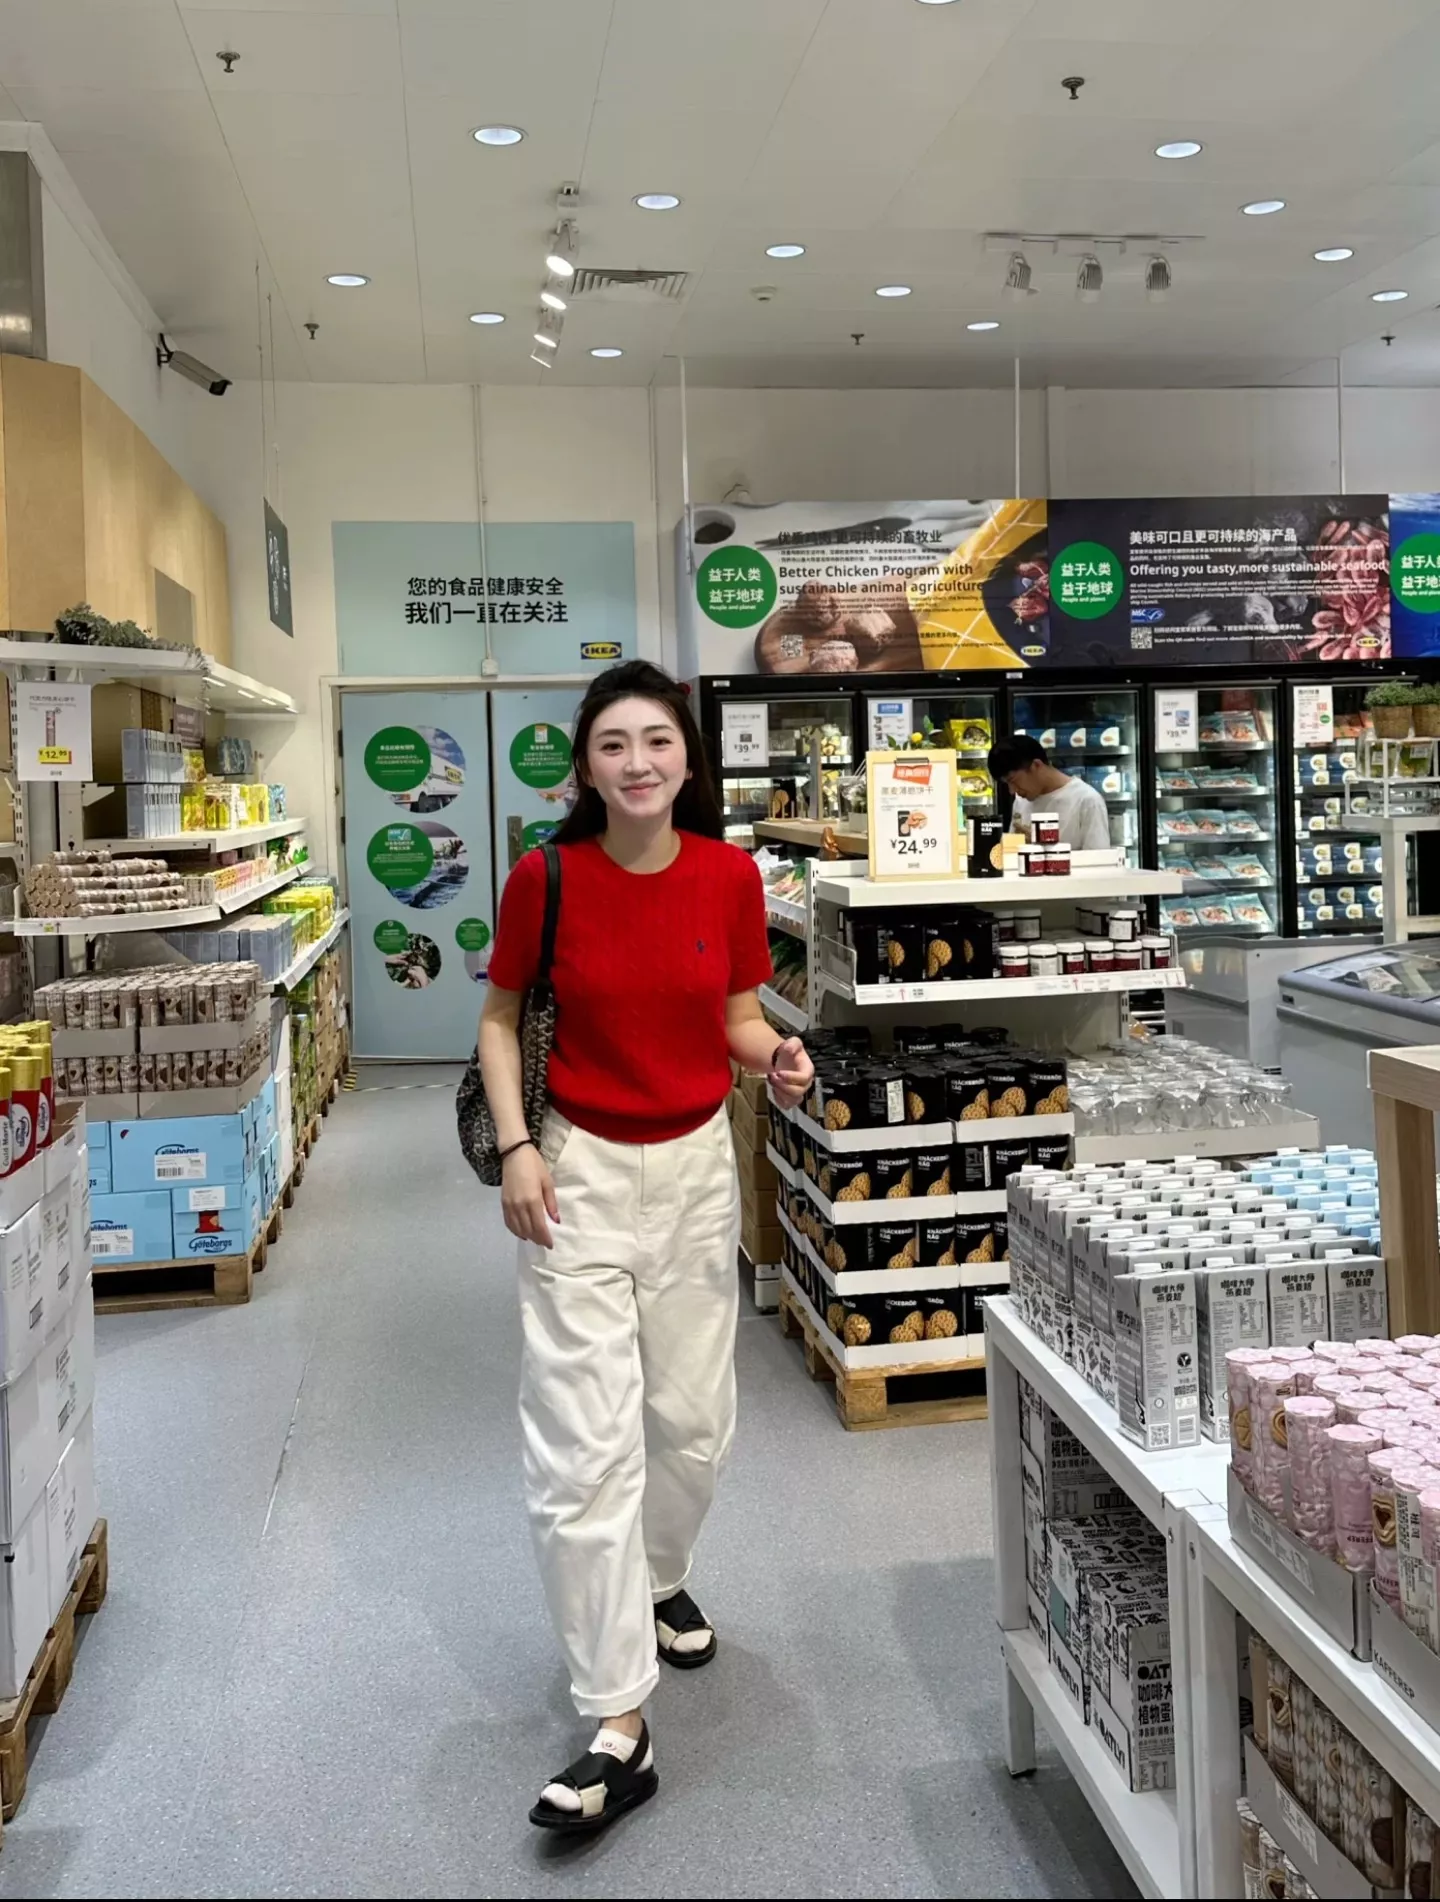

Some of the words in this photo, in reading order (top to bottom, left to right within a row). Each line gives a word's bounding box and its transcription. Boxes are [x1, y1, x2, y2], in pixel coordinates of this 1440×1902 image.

[836, 531, 943, 544] 更可持续的畜牧业
[1130, 528, 1297, 544] 美味可口且更可持续的海产品
[708, 567, 761, 582] 益于人类
[779, 567, 822, 578] Better
[825, 565, 878, 578] Chicken
[883, 565, 939, 578] Program
[943, 562, 974, 575] with
[1061, 562, 1111, 577] 益于人类
[1130, 565, 1179, 578] Offering
[1182, 566, 1204, 577] you
[1206, 564, 1270, 575] tasty,more
[1271, 562, 1338, 573] sustainable
[1340, 560, 1386, 572] seafood
[407, 576, 564, 597] 您的食品健康安全
[779, 582, 857, 595] sustainable
[861, 581, 908, 593] animal
[910, 580, 984, 595] agriculture
[1062, 581, 1114, 596] 益于地球
[1402, 575, 1440, 589] 益于地
[709, 588, 764, 603] 益于地球
[405, 601, 568, 624] 我们一直在关注
[584, 647, 619, 655] IKEA
[890, 838, 938, 855] ¥24.99
[189, 1236, 232, 1252] Göteborgs
[1374, 1648, 1416, 1700] KAFFEREP
[1137, 1681, 1172, 1703] 咖啡大
[1137, 1702, 1174, 1727] 植物蛋
